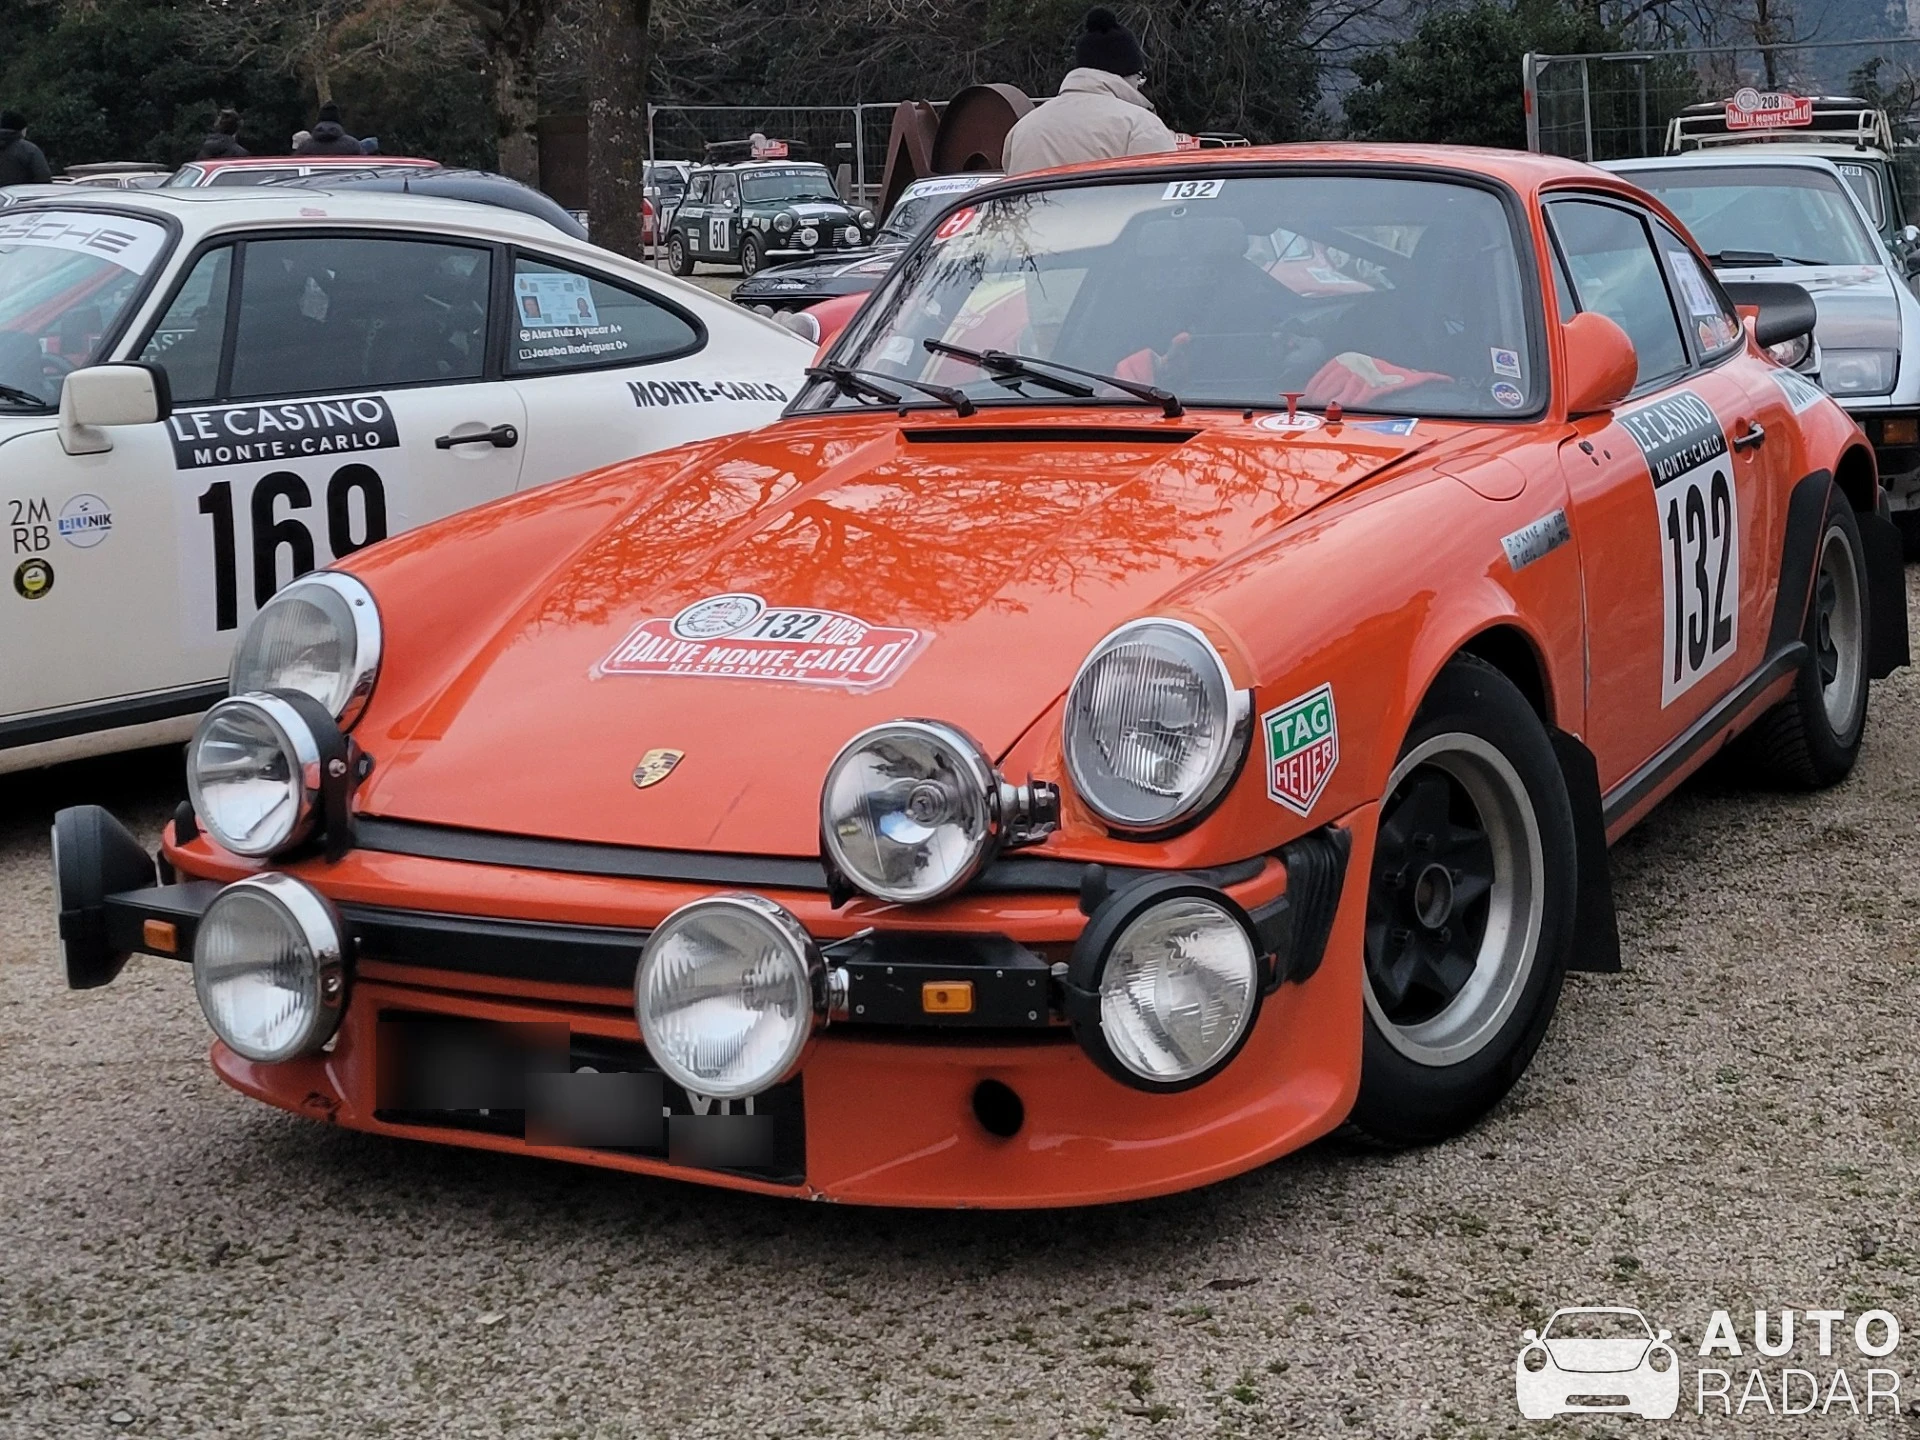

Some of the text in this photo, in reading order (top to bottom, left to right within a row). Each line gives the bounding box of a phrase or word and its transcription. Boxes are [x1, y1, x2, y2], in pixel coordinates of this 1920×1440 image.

[1729, 109, 1754, 124] RALLYE
[1761, 96, 1779, 109] 208
[1842, 166, 1860, 176] 208
[1171, 181, 1216, 198] 132
[713, 220, 725, 249] 50
[940, 211, 972, 235] H
[0, 223, 138, 254] SCHE
[531, 330, 552, 340] Alex
[553, 327, 575, 338] Ruiz
[575, 325, 609, 338] Ayucar
[531, 346, 567, 358] Joseba
[626, 381, 788, 408] MONTE-CARLO
[171, 399, 383, 441] LE CASINO
[1623, 394, 1713, 453] LE CASINO
[8, 497, 52, 526] 2M
[13, 525, 51, 554] RB
[198, 463, 388, 632] 169
[1667, 469, 1732, 685] 132
[751, 613, 823, 641] 132
[813, 616, 867, 647] 2025
[613, 631, 902, 675] RALLYE MONTE-CARLO
[668, 663, 807, 679] HISTORIQUE
[1274, 702, 1328, 752] TAG
[1276, 740, 1332, 800] HEUER
